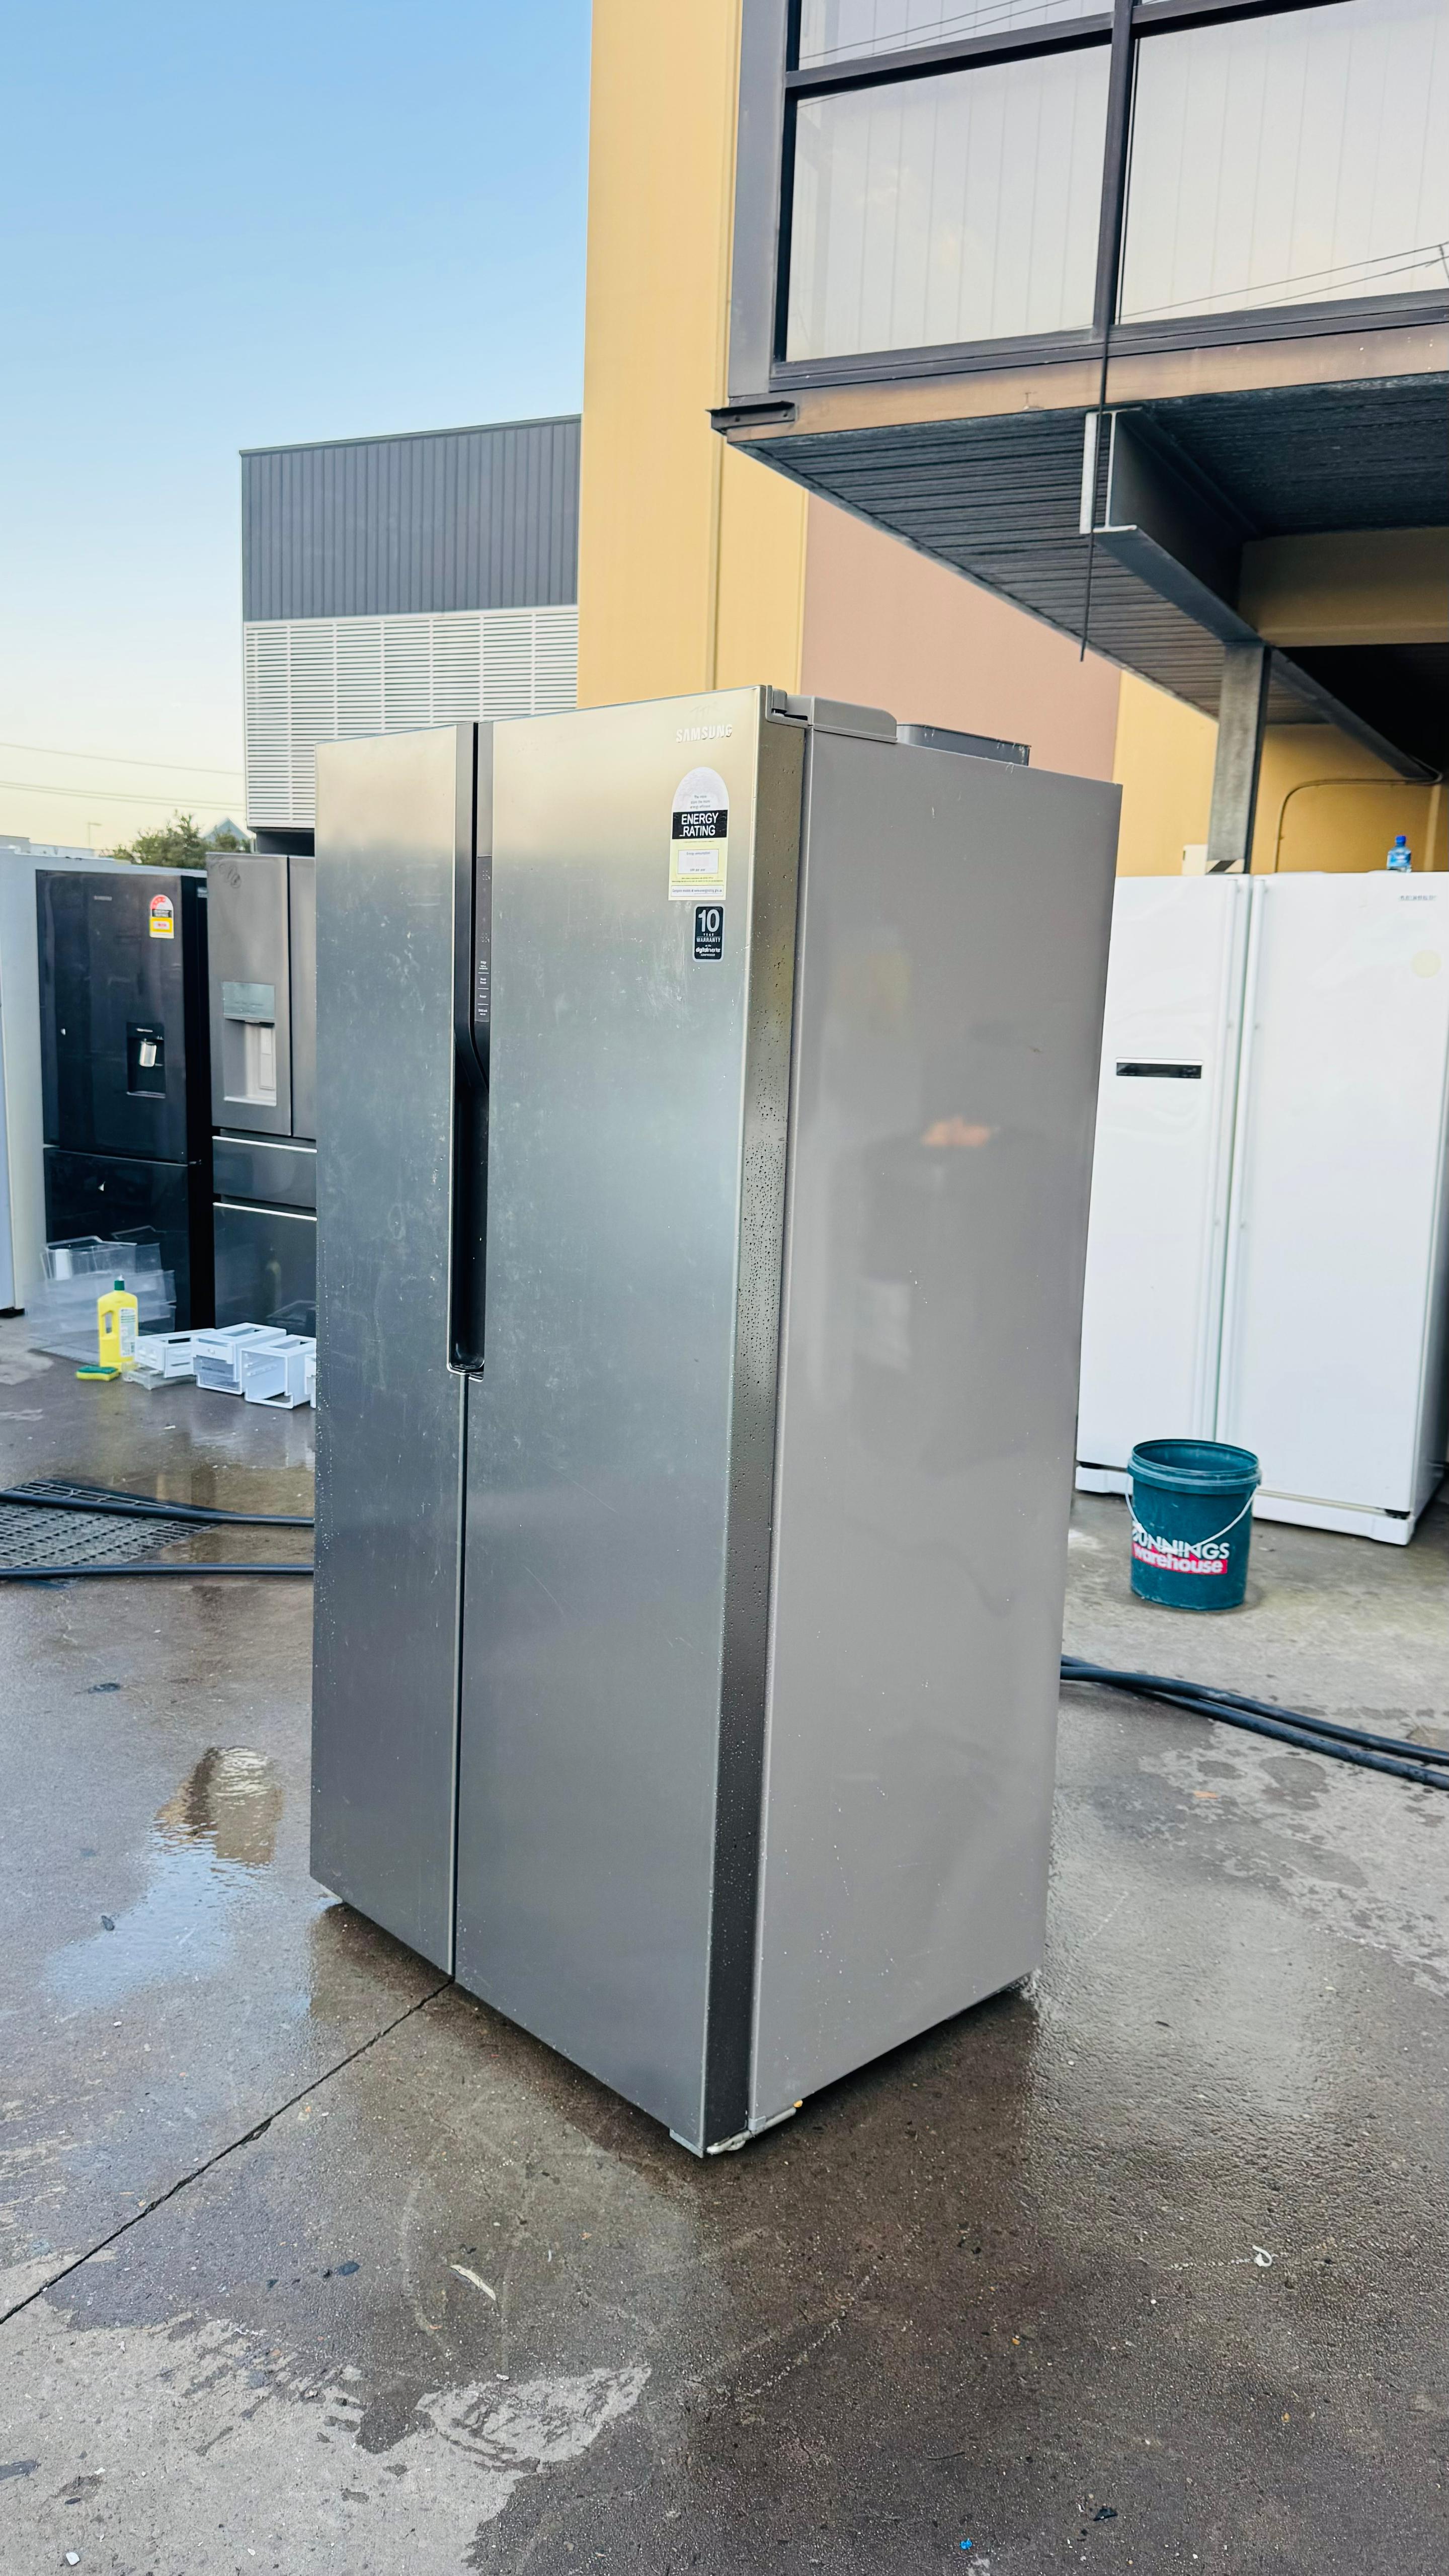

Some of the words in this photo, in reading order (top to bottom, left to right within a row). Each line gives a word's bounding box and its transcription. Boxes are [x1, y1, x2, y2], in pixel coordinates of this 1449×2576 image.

[676, 724, 733, 743] SAMSUNG
[681, 812, 719, 825] ENERGY
[680, 825, 715, 837] RATING
[698, 909, 720, 932] 10
[1134, 1545, 1224, 1574] warehouse
